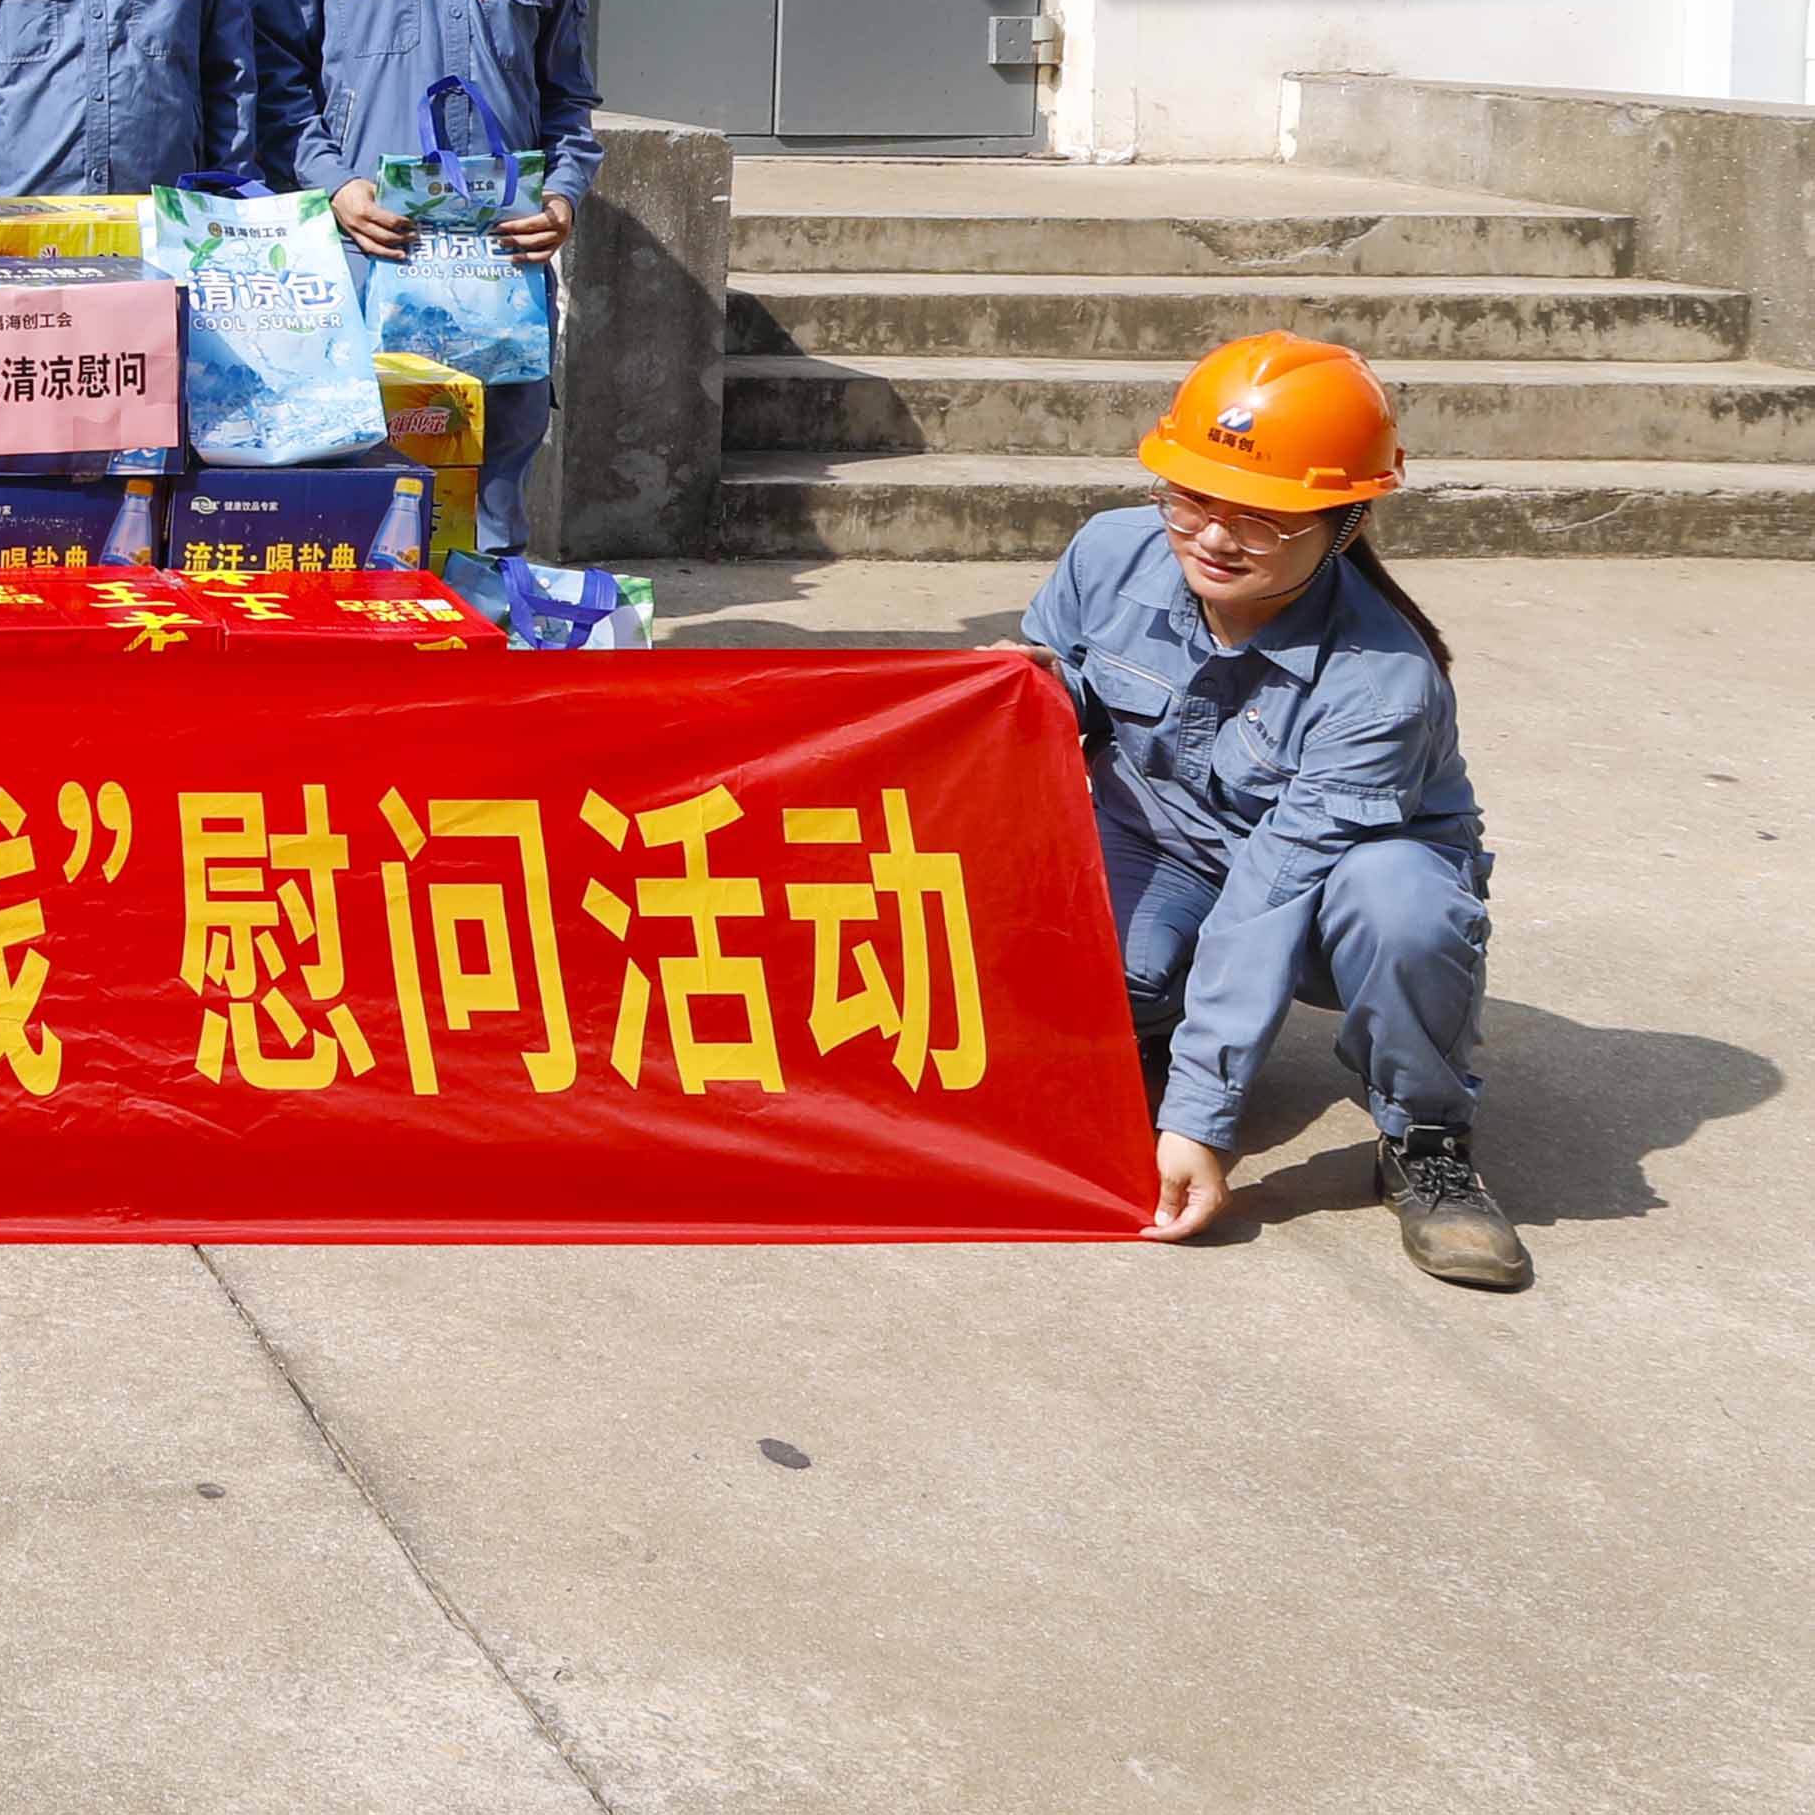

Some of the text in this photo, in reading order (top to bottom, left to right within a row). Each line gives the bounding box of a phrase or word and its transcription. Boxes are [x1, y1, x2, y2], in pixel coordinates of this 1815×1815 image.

[223, 225, 288, 238] 福海创工会
[395, 264, 523, 279] COOL SUMMER
[185, 268, 345, 313] 清凉包
[192, 313, 344, 330] COOL SUMMER
[1207, 426, 1255, 454] 福海创
[223, 500, 280, 512] 健康饮品专家
